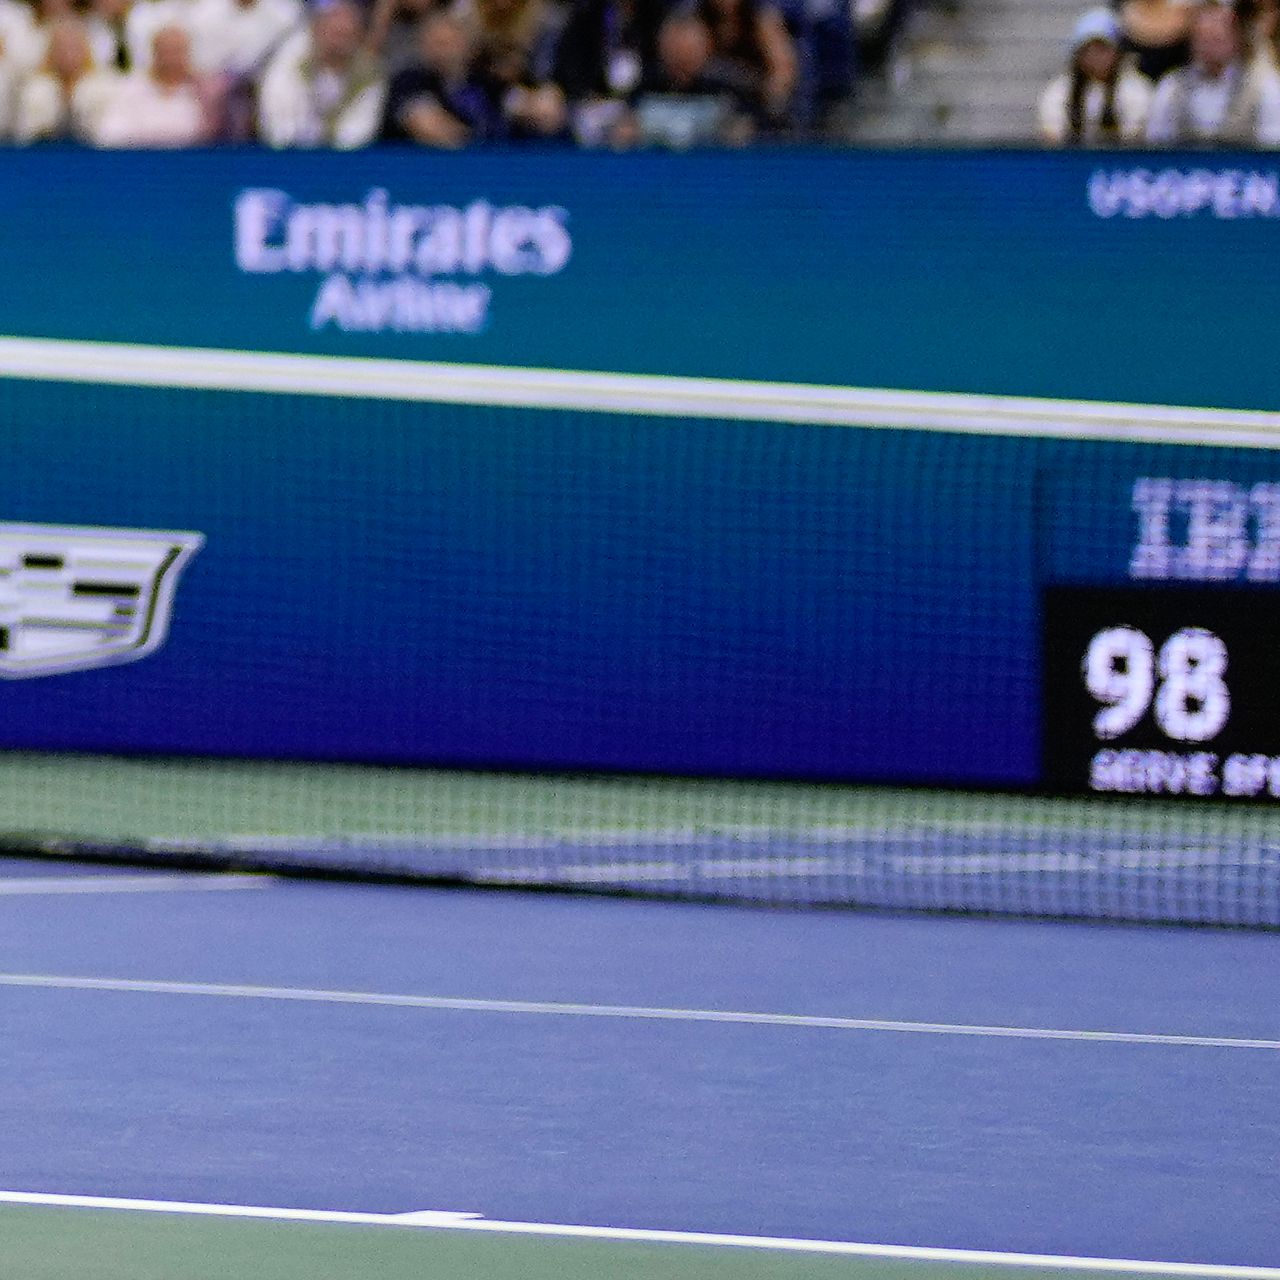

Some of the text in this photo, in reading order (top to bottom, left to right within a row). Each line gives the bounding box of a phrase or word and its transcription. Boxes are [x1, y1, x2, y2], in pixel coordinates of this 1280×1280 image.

[235, 187, 571, 275] Emirates
[1083, 624, 1231, 743] 98
[1089, 748, 1221, 796] SERVE
